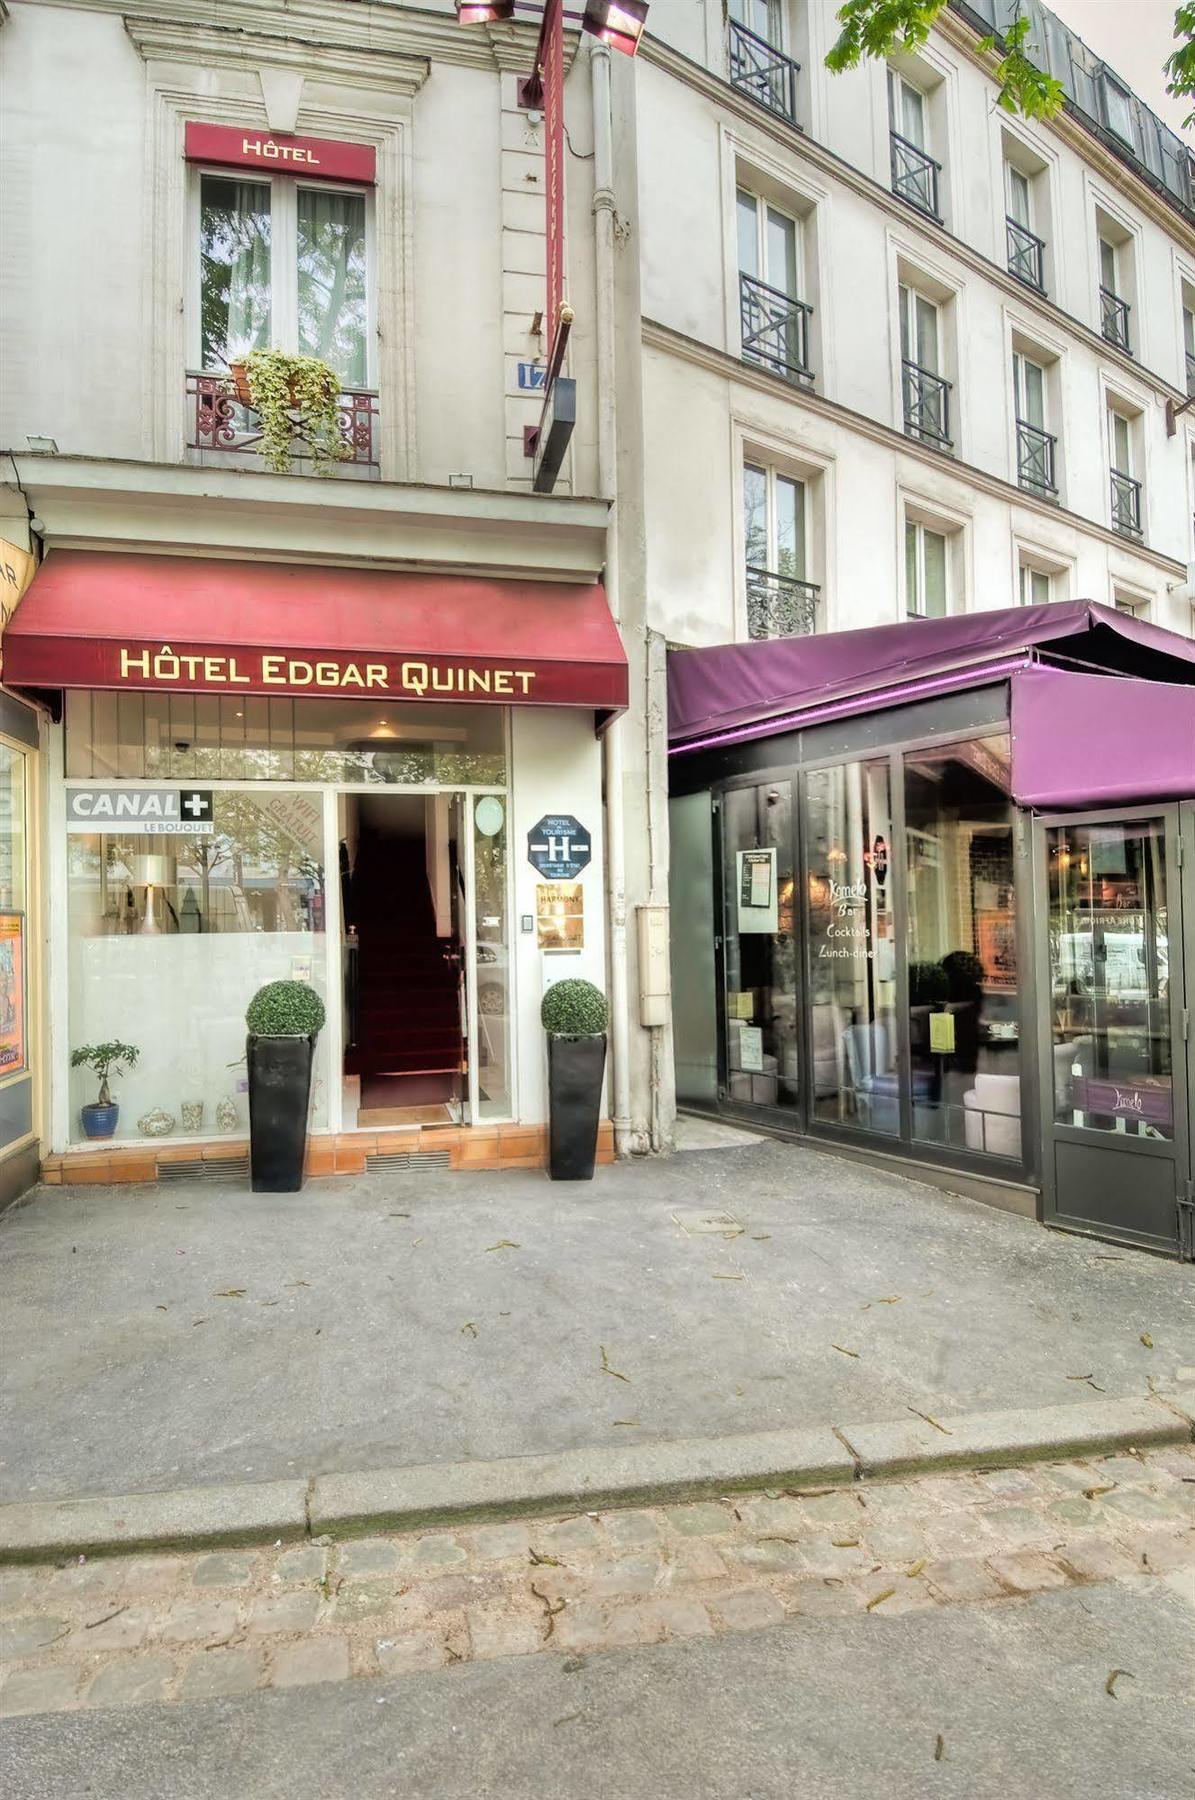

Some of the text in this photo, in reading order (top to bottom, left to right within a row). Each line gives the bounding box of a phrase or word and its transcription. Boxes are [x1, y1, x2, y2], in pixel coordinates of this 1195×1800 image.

[243, 138, 320, 164] HÔTEL
[523, 365, 547, 388] 17
[119, 646, 536, 696] HÔTEL EDGAR QUINET
[269, 798, 319, 843] GRATUIT
[292, 794, 321, 825] WIFI
[159, 823, 214, 833] BOUQUET
[547, 836, 571, 862] H
